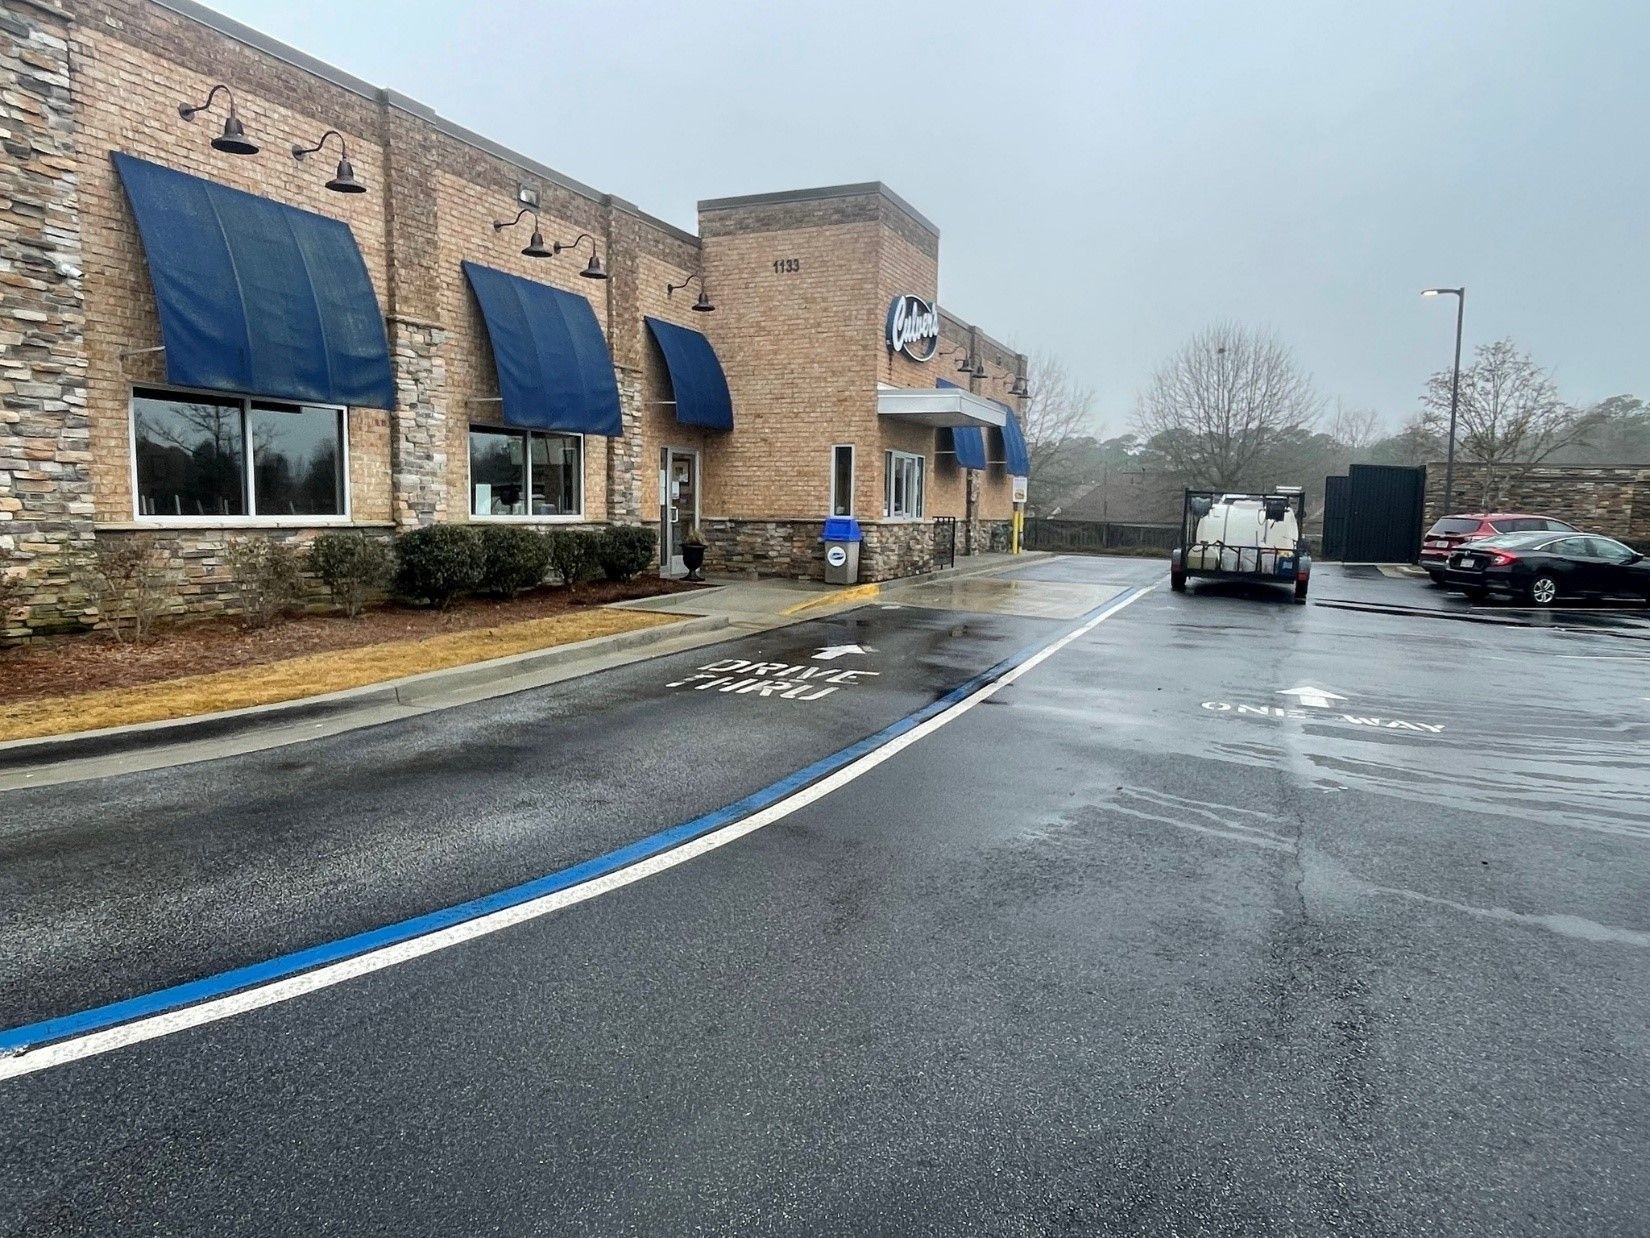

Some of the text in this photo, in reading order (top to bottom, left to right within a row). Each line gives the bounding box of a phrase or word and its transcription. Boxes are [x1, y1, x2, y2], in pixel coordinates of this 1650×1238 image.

[773, 258, 800, 274] 1133
[892, 295, 939, 352] Culver's
[665, 672, 840, 700] THRU
[697, 659, 880, 685] DRIVE
[1201, 701, 1446, 733] ONE WAY
